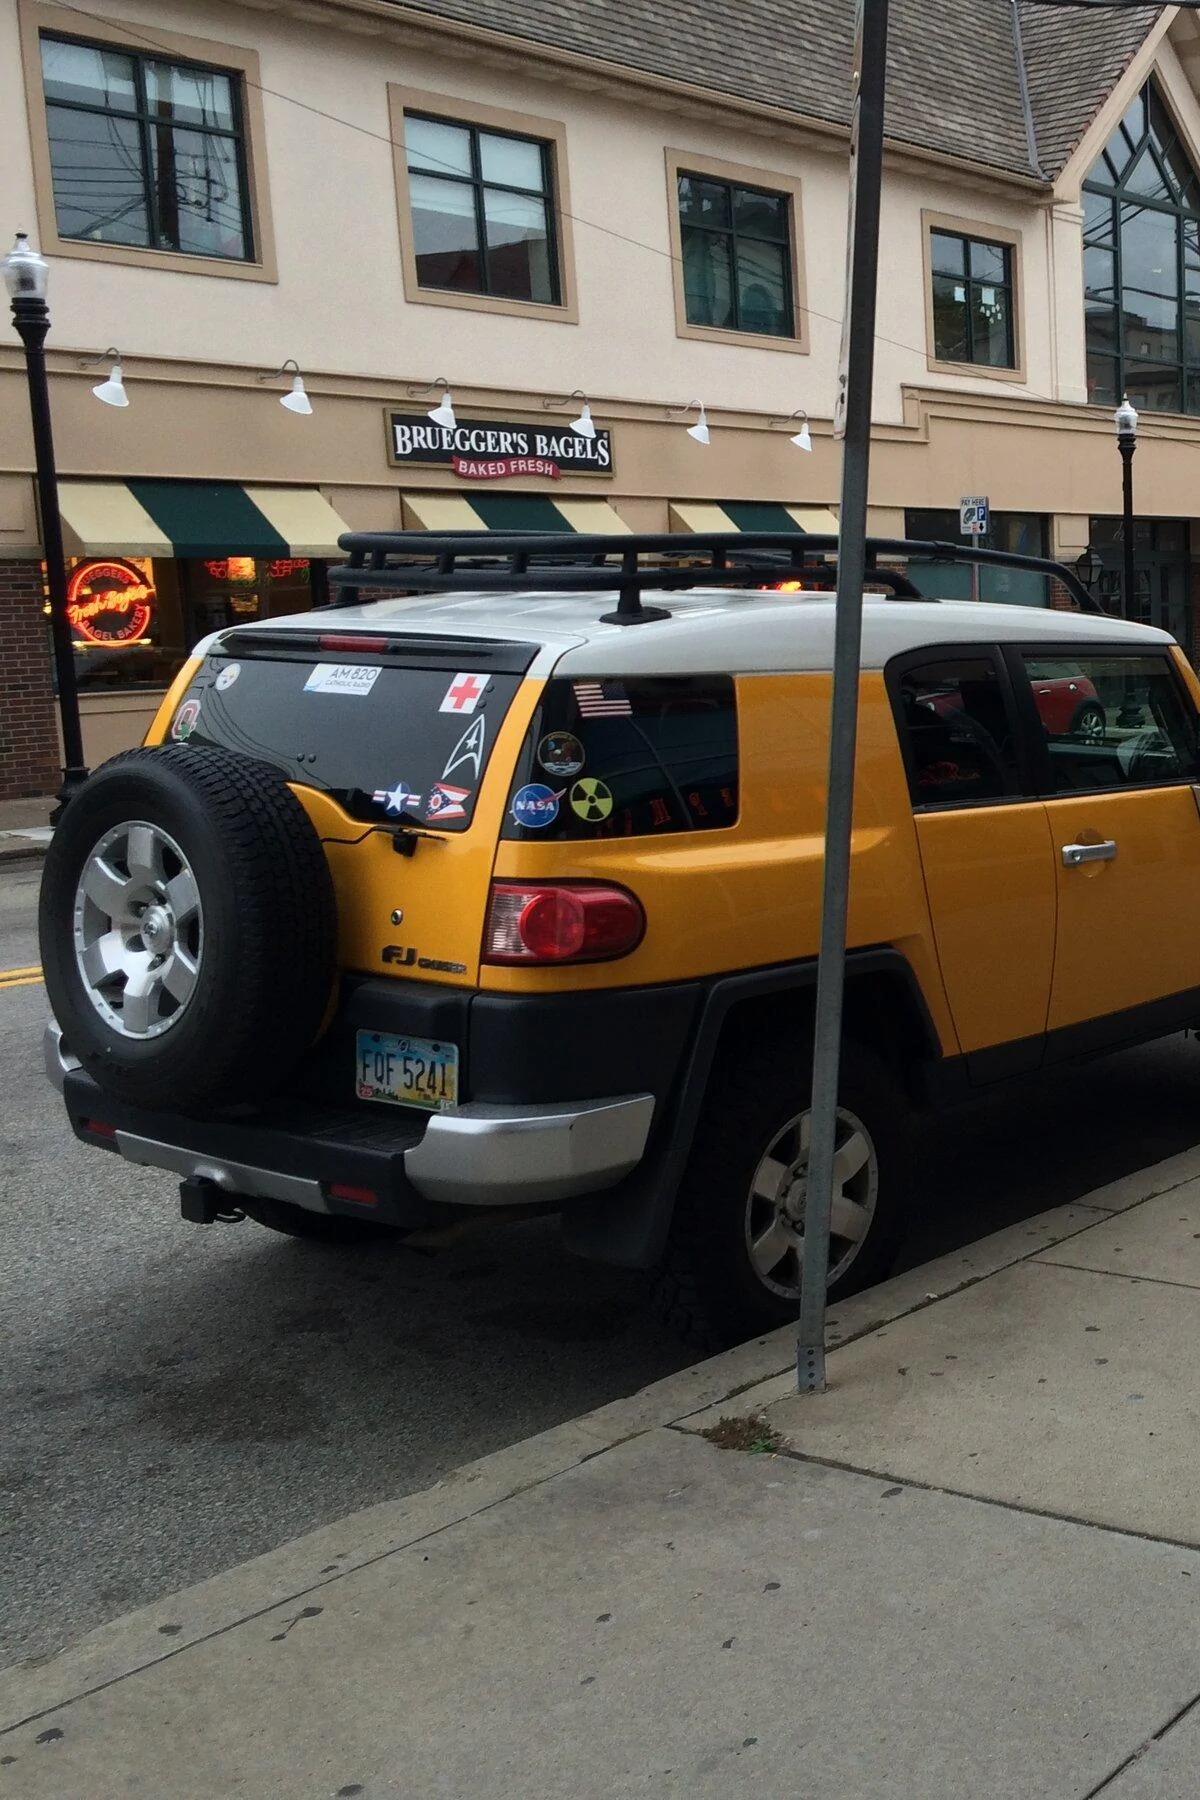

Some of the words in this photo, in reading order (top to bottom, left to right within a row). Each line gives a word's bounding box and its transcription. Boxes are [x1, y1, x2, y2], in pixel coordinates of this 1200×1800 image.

[394, 424, 528, 456] BRUEGGER'S
[534, 434, 610, 466] BAGELS
[458, 459, 506, 475] BAKED
[510, 459, 554, 476] FRESH
[82, 619, 115, 640] BAGEL
[117, 603, 146, 639] BAKERY
[329, 668, 351, 679] AM
[351, 668, 378, 681] 820
[515, 799, 555, 812] NASA
[382, 945, 417, 967] FJ
[362, 1048, 397, 1086] FQF
[403, 1056, 447, 1097] 5241
